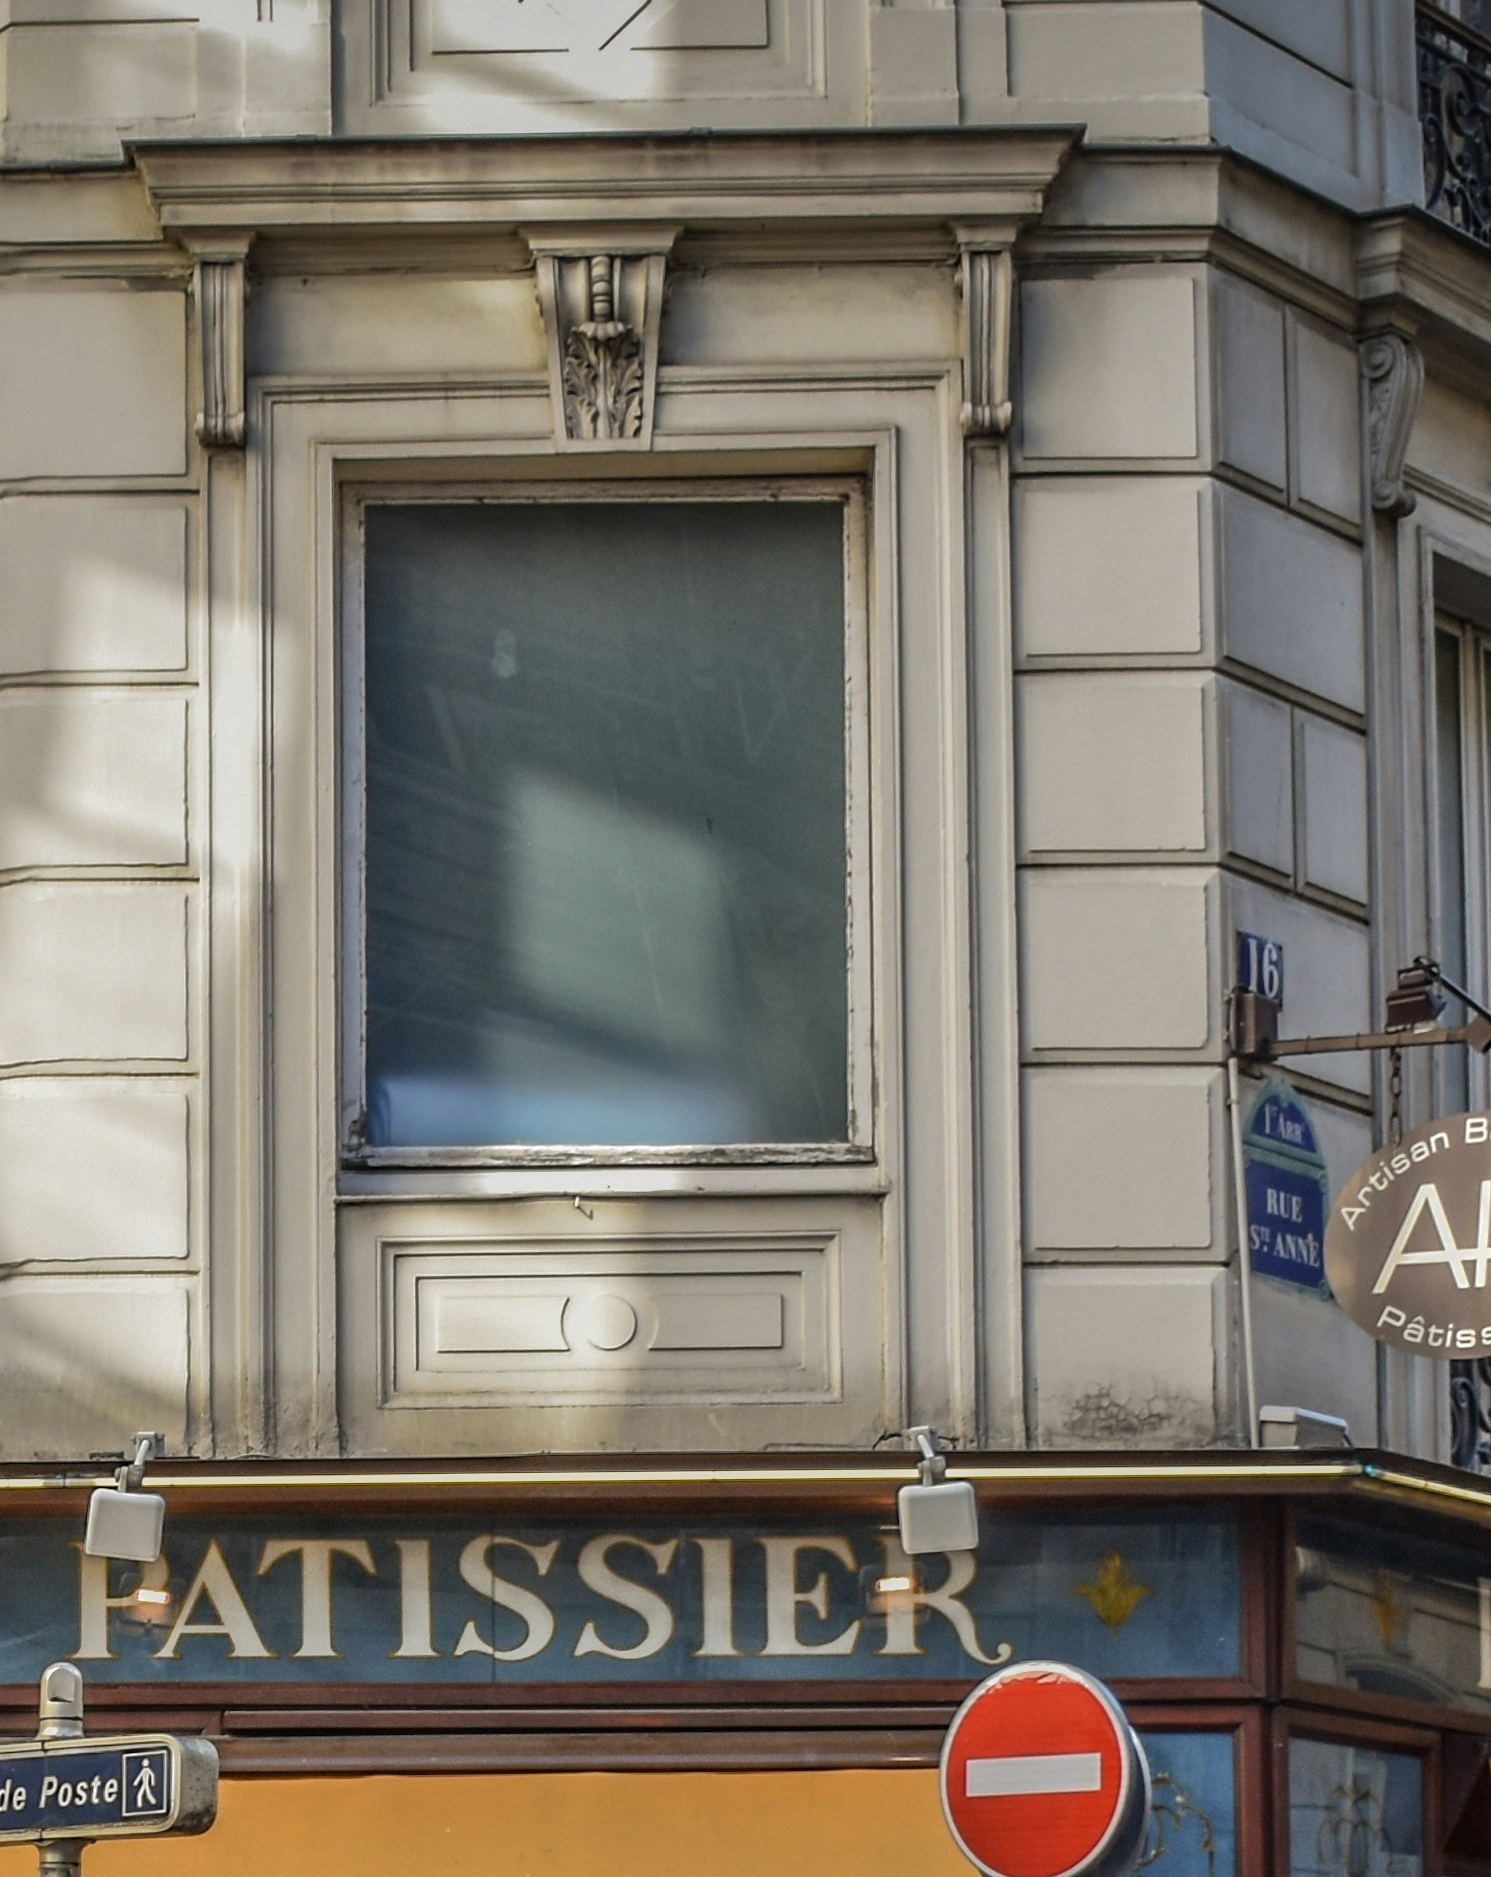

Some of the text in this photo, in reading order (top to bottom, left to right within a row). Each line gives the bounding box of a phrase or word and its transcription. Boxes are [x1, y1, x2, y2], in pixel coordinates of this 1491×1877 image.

[1248, 938, 1279, 998] 16
[1266, 1187, 1304, 1224] RUE
[1340, 1130, 1451, 1232] Artisan
[1274, 1232, 1320, 1268] ANNE
[69, 1530, 1015, 1666] PATISSIER
[39, 1771, 119, 1810] Poste
